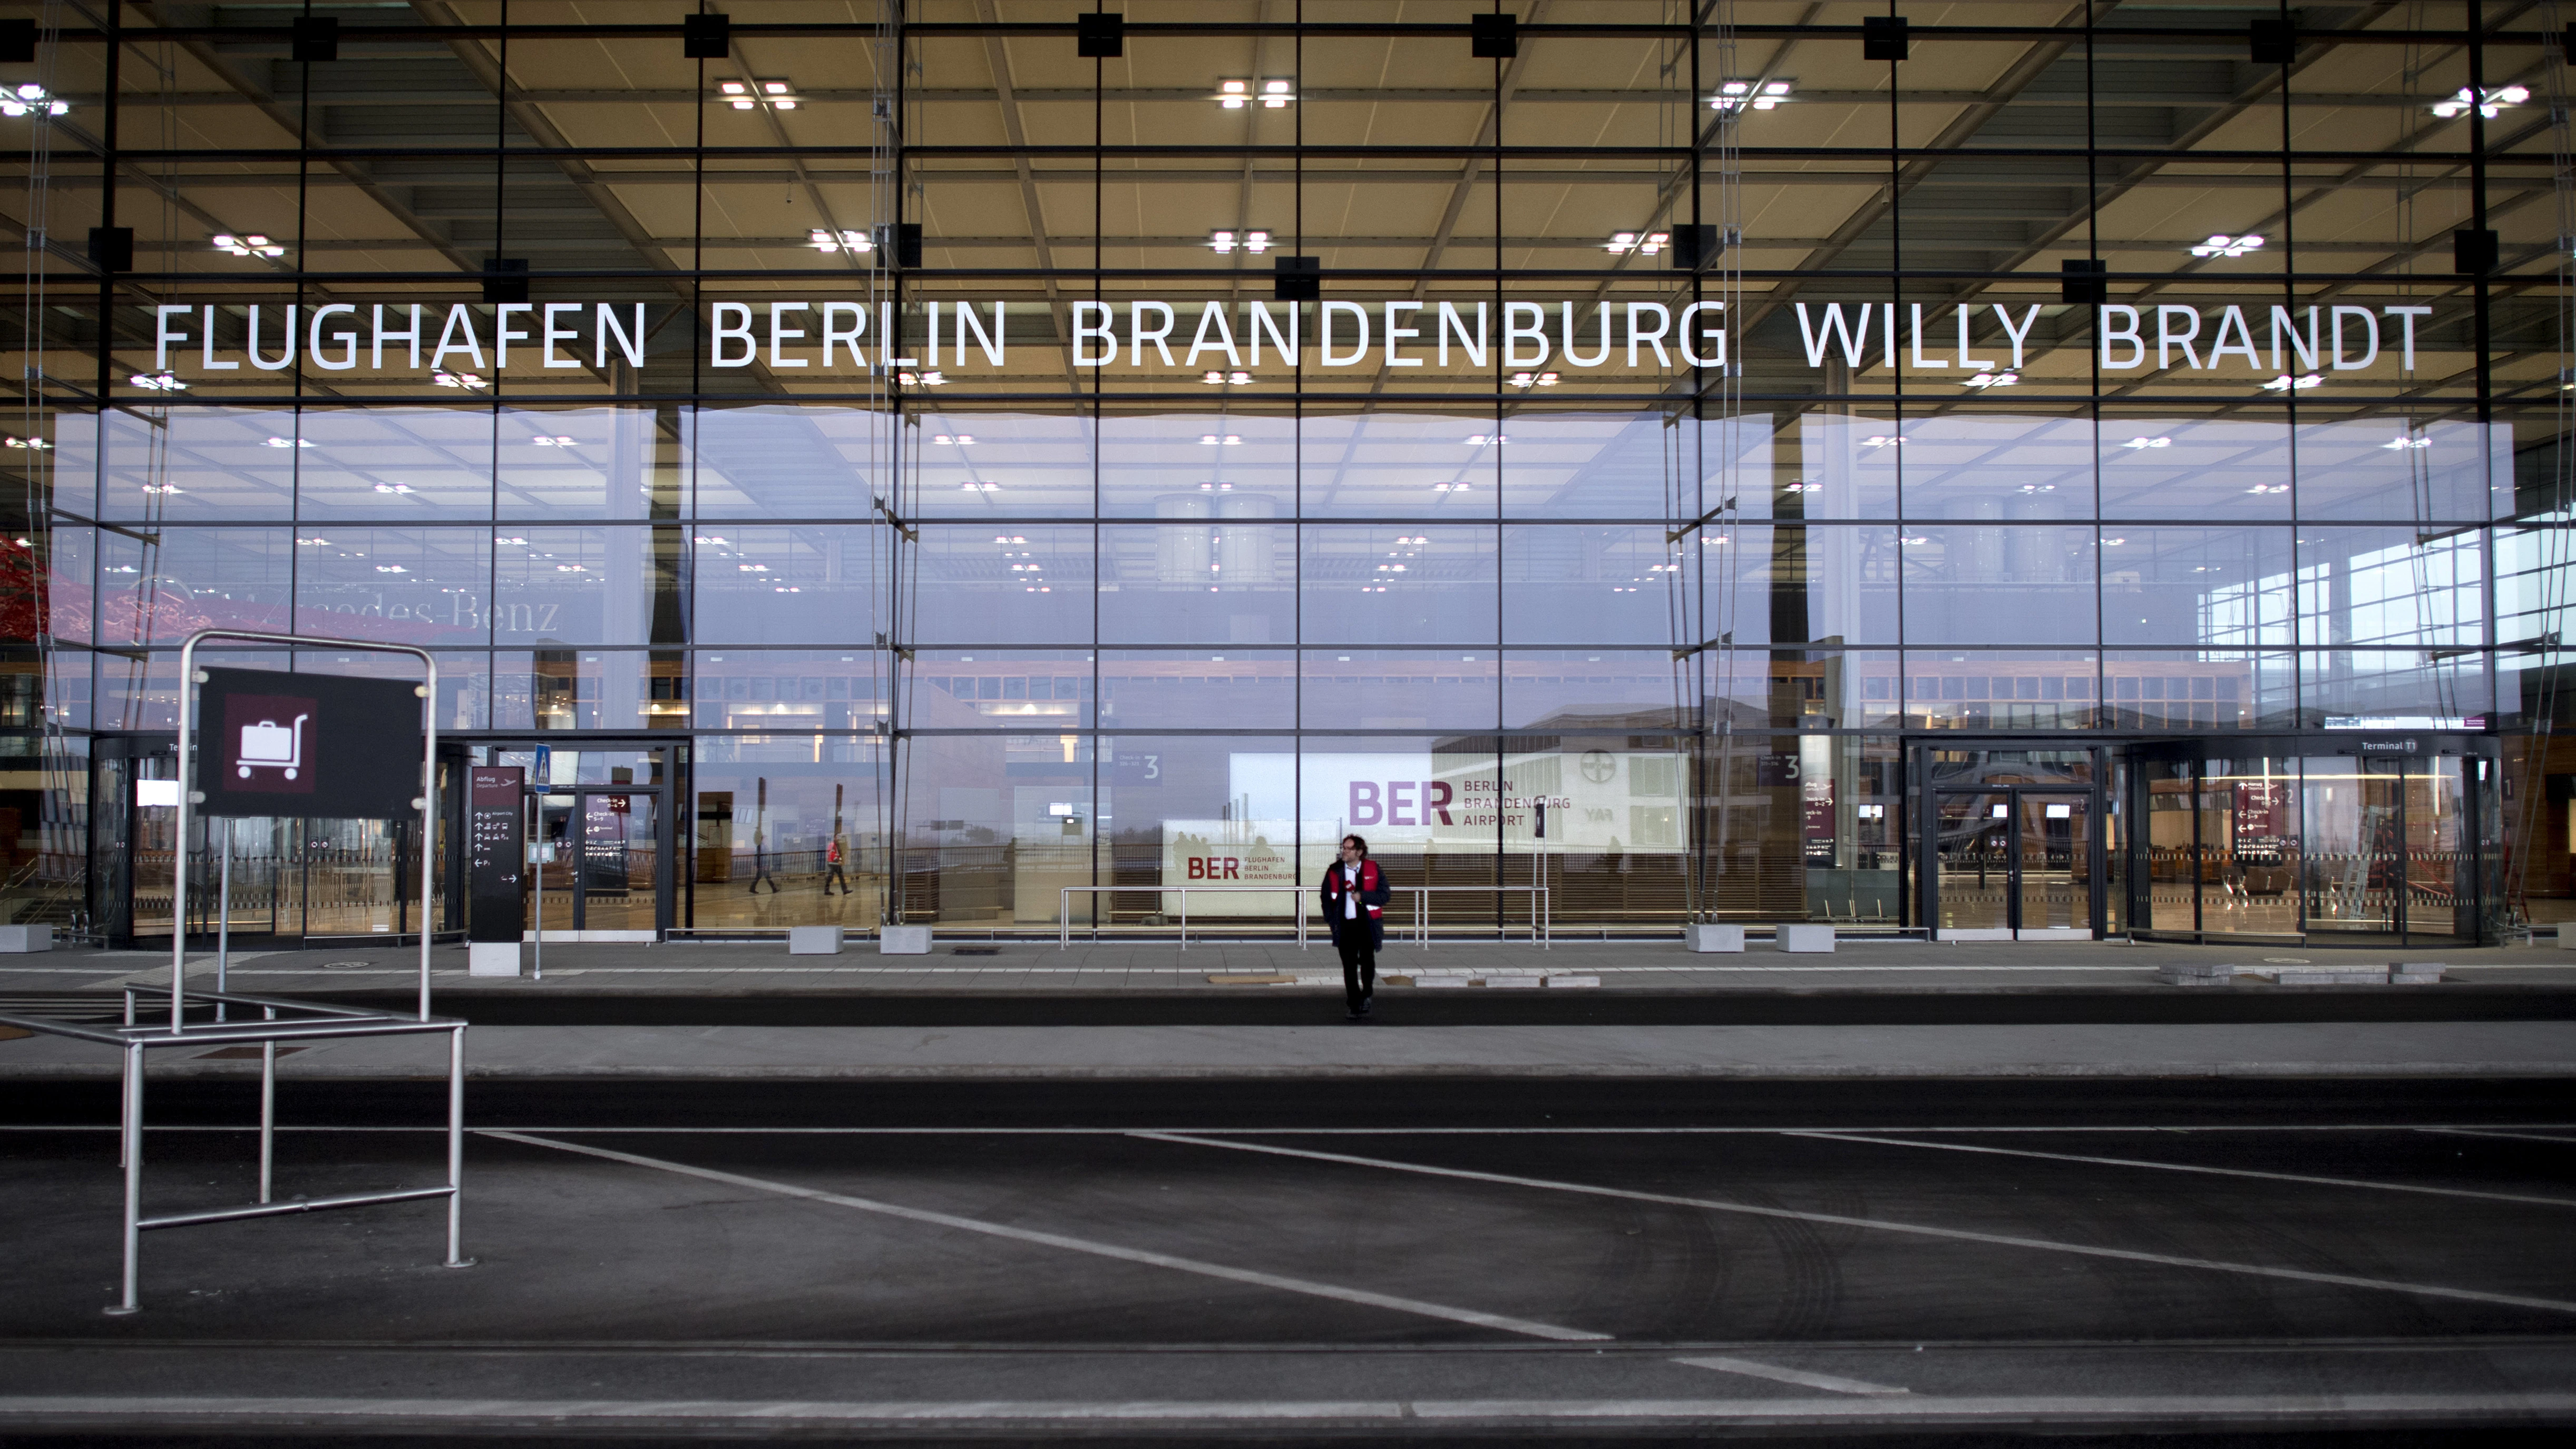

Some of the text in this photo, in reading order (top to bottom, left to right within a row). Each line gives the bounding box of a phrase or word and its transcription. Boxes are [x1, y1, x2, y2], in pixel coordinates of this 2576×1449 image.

[157, 301, 2432, 371] FLUGHAFEN BERLIN BRANDENBURG WILLY BRANDT
[2362, 741, 2403, 750] Terminal
[1144, 755, 1158, 779] 3
[1785, 755, 1799, 779] 3
[1465, 781, 1513, 791] BERLN
[1350, 781, 1453, 826] BER
[1188, 857, 1240, 879] BER
